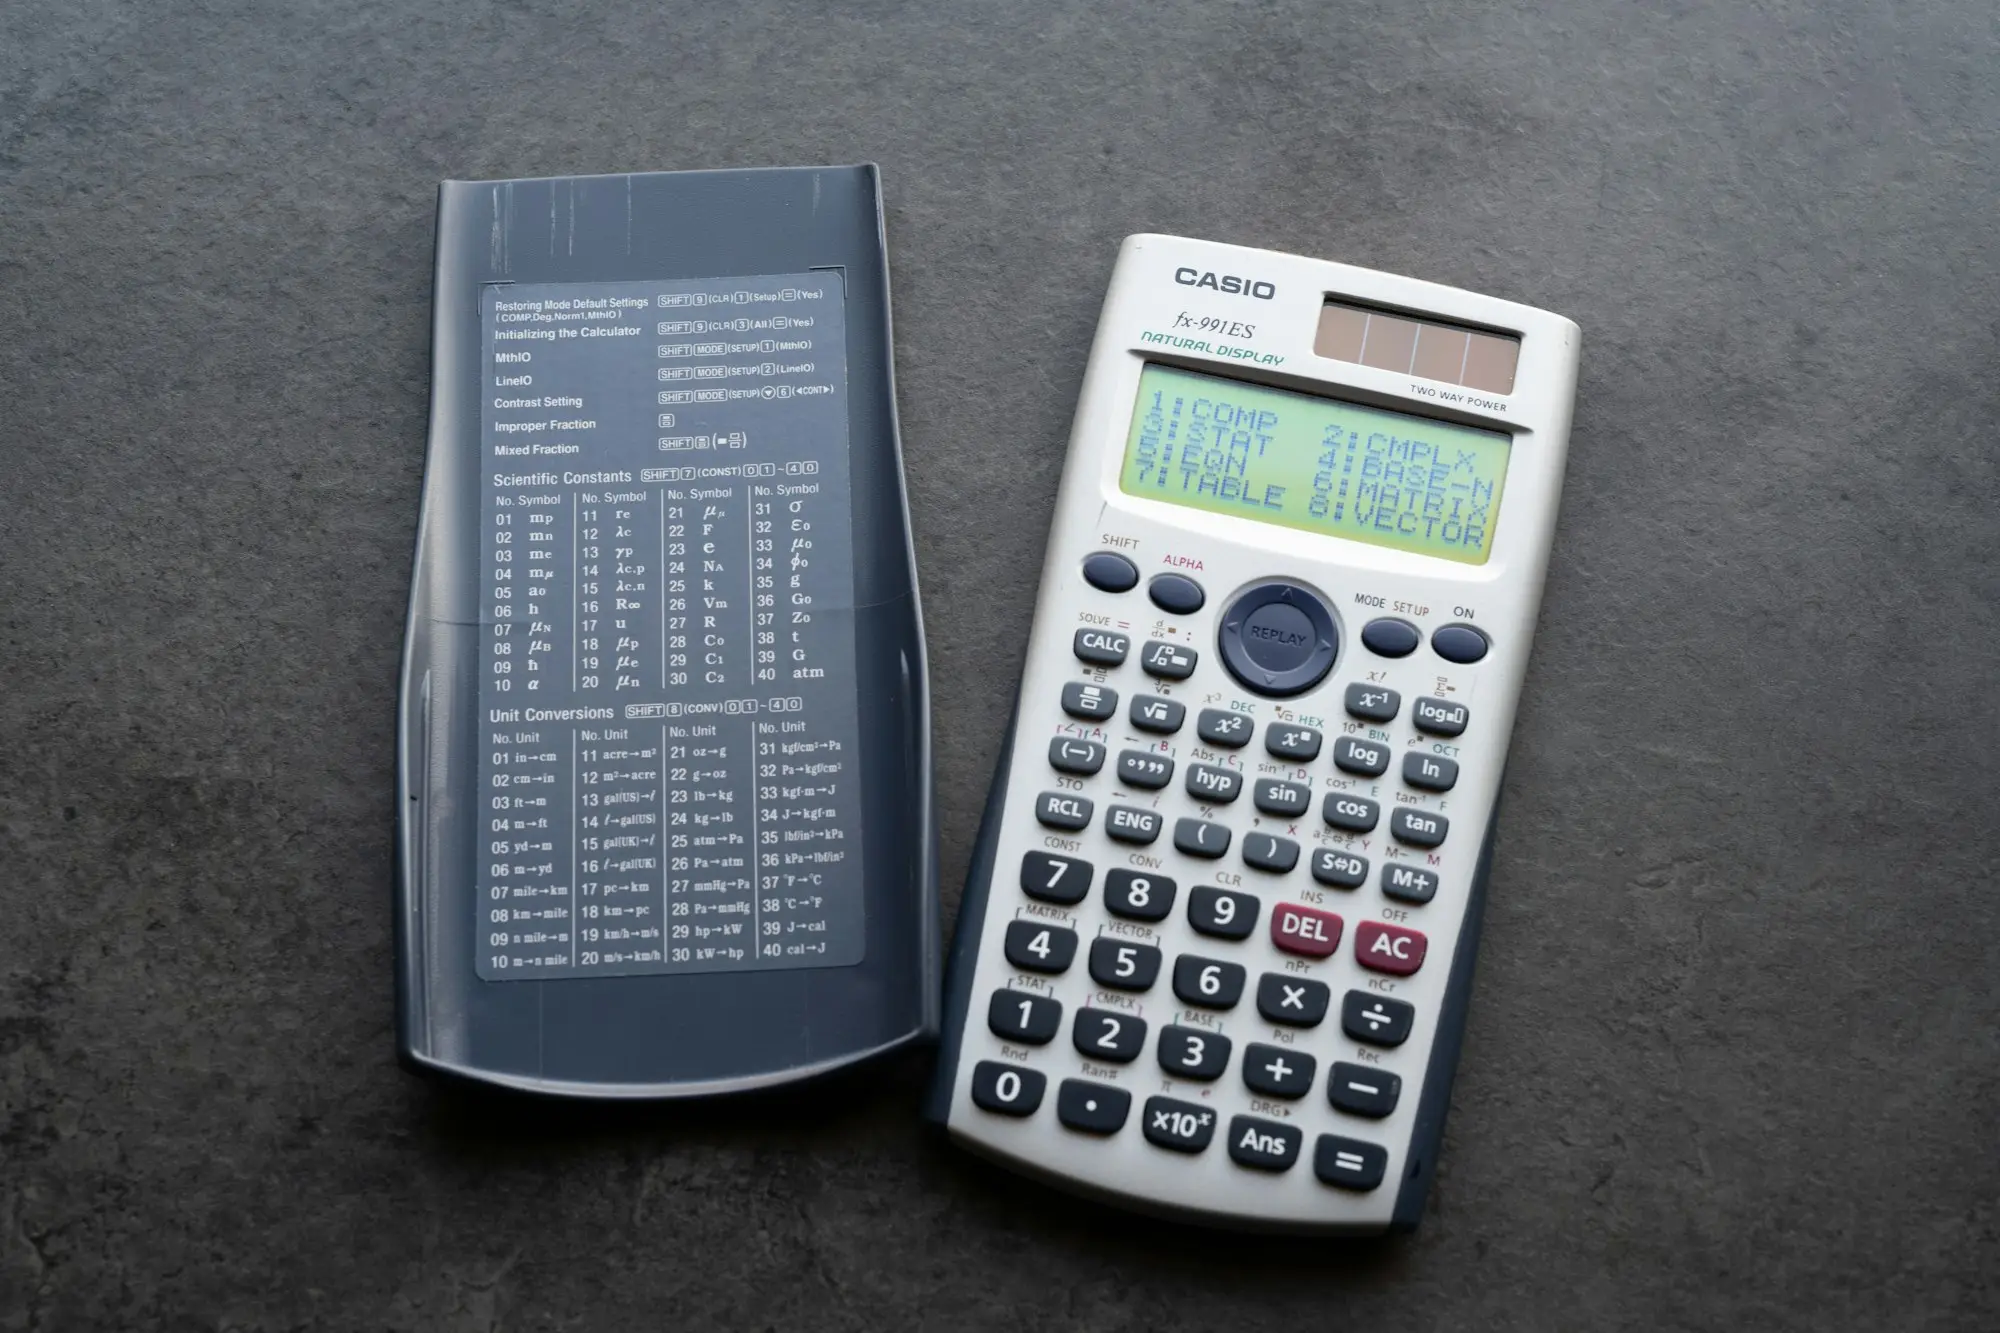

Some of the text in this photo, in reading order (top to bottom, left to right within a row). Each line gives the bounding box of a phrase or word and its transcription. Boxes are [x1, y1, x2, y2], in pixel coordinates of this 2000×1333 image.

[1174, 267, 1276, 300] CASIO
[495, 297, 649, 313] Restoring Mode Default Settings
[660, 295, 690, 306] SHIFT
[660, 323, 690, 333] SHIFT
[1173, 311, 1256, 339] fx-991ES
[495, 325, 641, 341] Initializing the Calculator
[660, 346, 690, 357] SHIFT
[697, 345, 724, 354] MODE
[1141, 331, 1284, 366] NATURAL DISPLAY
[496, 352, 531, 363] MthIO
[496, 375, 532, 386] LineIO
[660, 370, 690, 380] SHIFT
[698, 368, 725, 377] MODE
[494, 396, 583, 409] Contrast Setting
[660, 392, 690, 402] SHIFT
[698, 391, 725, 400] MODE
[1411, 384, 1507, 412] TWO WAY POWER
[495, 418, 596, 433] Improper Fraction
[495, 444, 579, 456] Mixed Fraction
[661, 438, 690, 449] SHIFT
[494, 473, 558, 487] Scientific
[564, 471, 631, 484] Constants
[644, 470, 676, 481] SHIFT
[668, 488, 732, 502] No. Symbol
[755, 484, 819, 497] No. Symbol
[496, 494, 560, 508] No. Symbol
[582, 492, 646, 505] No. Symbol
[755, 503, 771, 514] 31
[496, 513, 512, 525] 01
[669, 526, 684, 537] 22
[1102, 534, 1140, 549] SHIFT
[1163, 555, 1204, 571] ALPHA
[669, 581, 685, 592] 25
[1354, 593, 1386, 608] MODE
[1079, 612, 1110, 626] SOLVE
[1454, 606, 1474, 619] ON
[669, 618, 686, 629] 27
[1083, 634, 1126, 652] CALC
[1251, 626, 1306, 646] REPLAY
[758, 650, 775, 662] 39
[758, 667, 824, 680] 40 atm
[1231, 701, 1256, 713] DEC
[490, 709, 519, 723] Unit
[525, 706, 614, 721] Conversions
[628, 706, 662, 717] SHIFT
[1299, 715, 1324, 728] HEX
[670, 726, 716, 737] No. Unit
[759, 721, 805, 733] No. Unit
[492, 732, 539, 744] No. Unit
[582, 729, 628, 741] No. Unit
[1369, 730, 1390, 742] BIN
[671, 747, 686, 758] 21
[1191, 748, 1214, 761] Abs
[1349, 743, 1378, 766] log
[1433, 744, 1459, 757] OCT
[493, 753, 509, 764] 01
[760, 765, 776, 777] 32
[1422, 760, 1440, 778] ln
[1056, 778, 1083, 791] STO
[1197, 769, 1231, 790] hyp
[1269, 785, 1296, 802] sin
[1048, 799, 1082, 818] RCL
[1336, 801, 1368, 818] cos
[1114, 811, 1152, 830] ENG
[1405, 814, 1436, 834] tan
[672, 837, 688, 848] 25
[1044, 837, 1081, 852] CONST
[1129, 854, 1162, 869] CONV
[1047, 860, 1068, 888] 7
[1216, 872, 1242, 886] CLR
[1392, 869, 1429, 891] M+
[762, 877, 779, 889] 37
[1128, 879, 1150, 907] 8
[1300, 890, 1324, 904] INS
[1025, 904, 1068, 921] MATRIX
[1214, 896, 1236, 925] 9
[1382, 908, 1408, 922] OFF
[1108, 921, 1153, 939] VECTOR
[1282, 913, 1329, 942] DEL
[764, 944, 781, 956] 40
[1027, 931, 1050, 959] 4
[1371, 933, 1411, 959] AC
[491, 956, 508, 968] 10
[582, 952, 598, 964] 20
[672, 949, 690, 961] 30
[1115, 948, 1137, 976] 5
[1017, 975, 1046, 989] STAT
[1200, 965, 1221, 995] 6
[1018, 1000, 1033, 1029] 1
[1184, 1011, 1215, 1026] BASE
[1097, 1019, 1120, 1048] 2
[1182, 1037, 1204, 1066] 3
[996, 1072, 1021, 1102] 0
[1240, 1128, 1286, 1155] Ans
